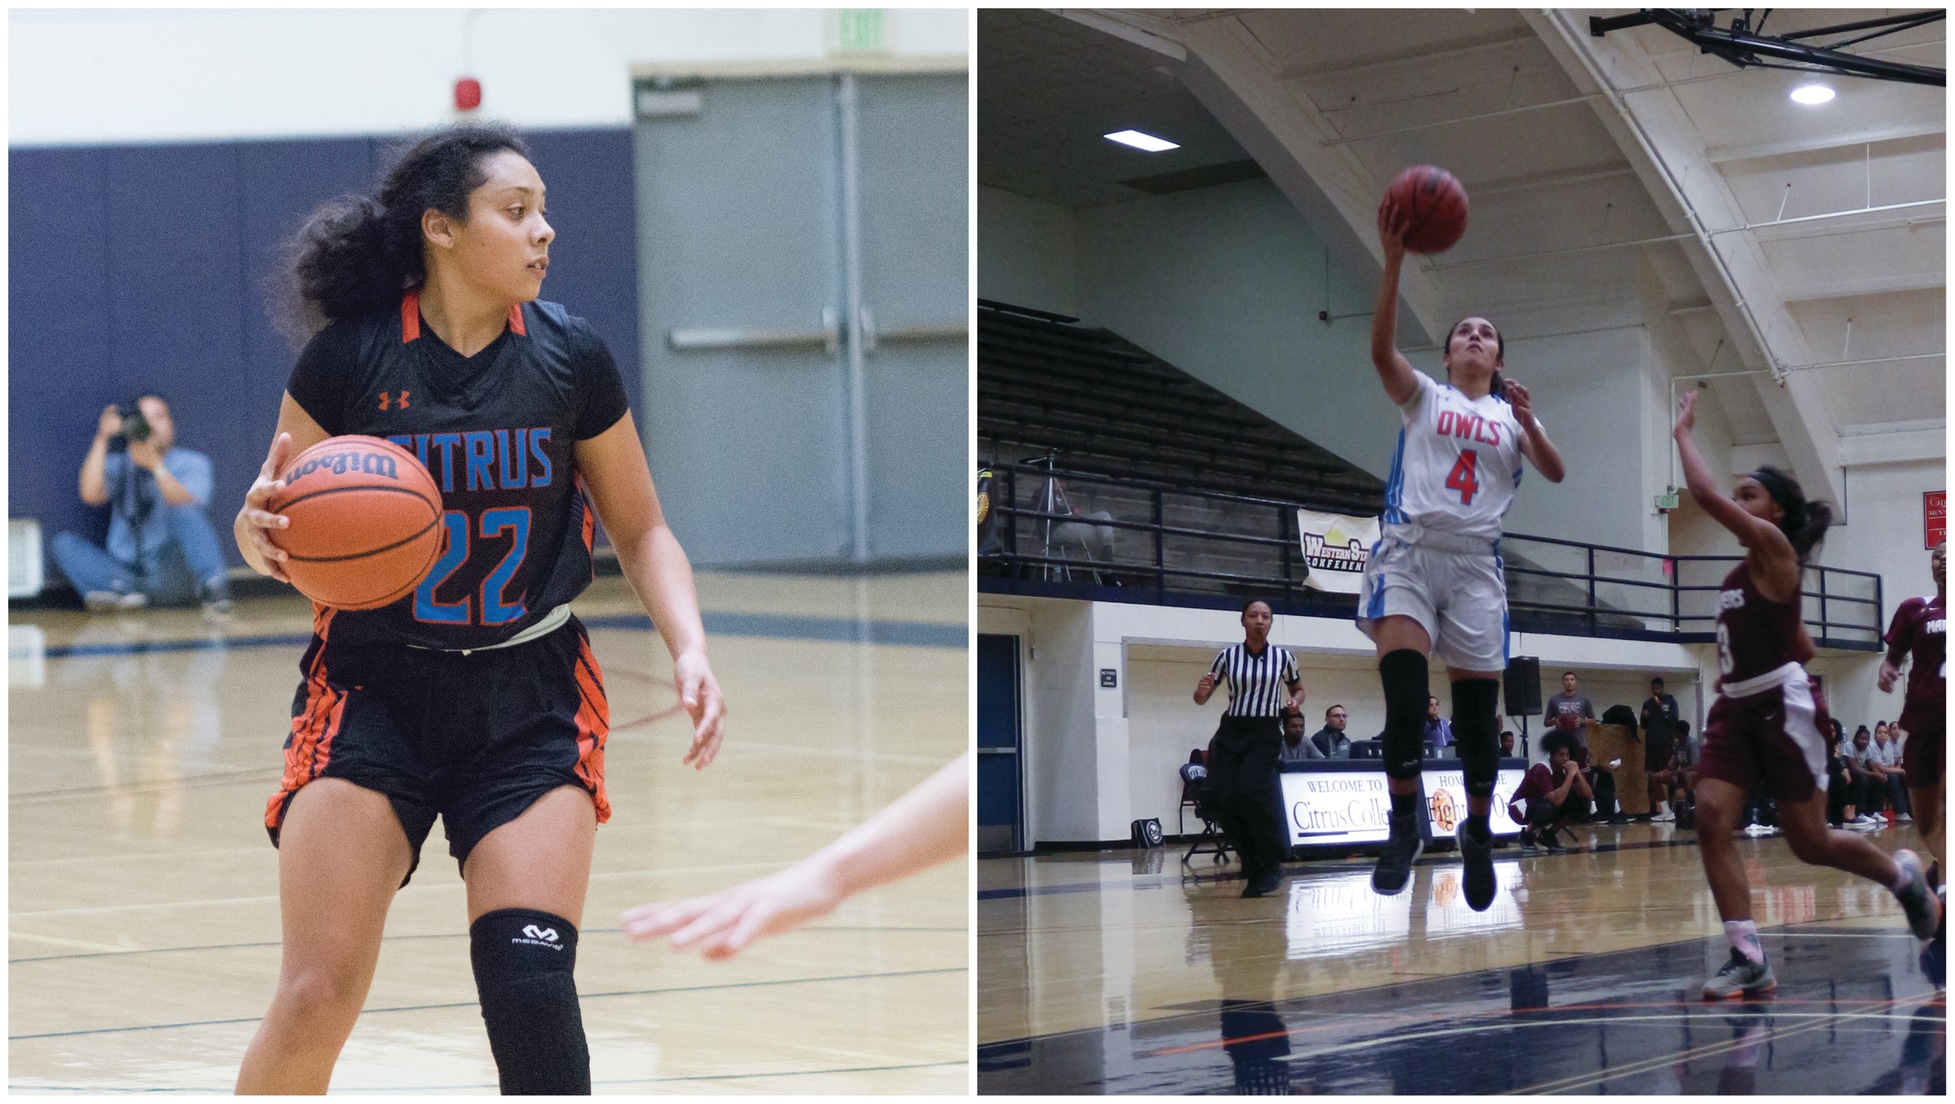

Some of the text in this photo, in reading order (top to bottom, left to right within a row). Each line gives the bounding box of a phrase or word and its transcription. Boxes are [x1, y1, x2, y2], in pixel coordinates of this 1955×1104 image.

[1437, 410, 1501, 447] OWLS
[286, 452, 399, 486] Wilson
[386, 427, 551, 493] ITRUS
[1445, 448, 1479, 506] 4
[413, 505, 532, 627] 22
[1307, 779, 1382, 793] WELCOME TO
[1293, 801, 1347, 830] Citrus
